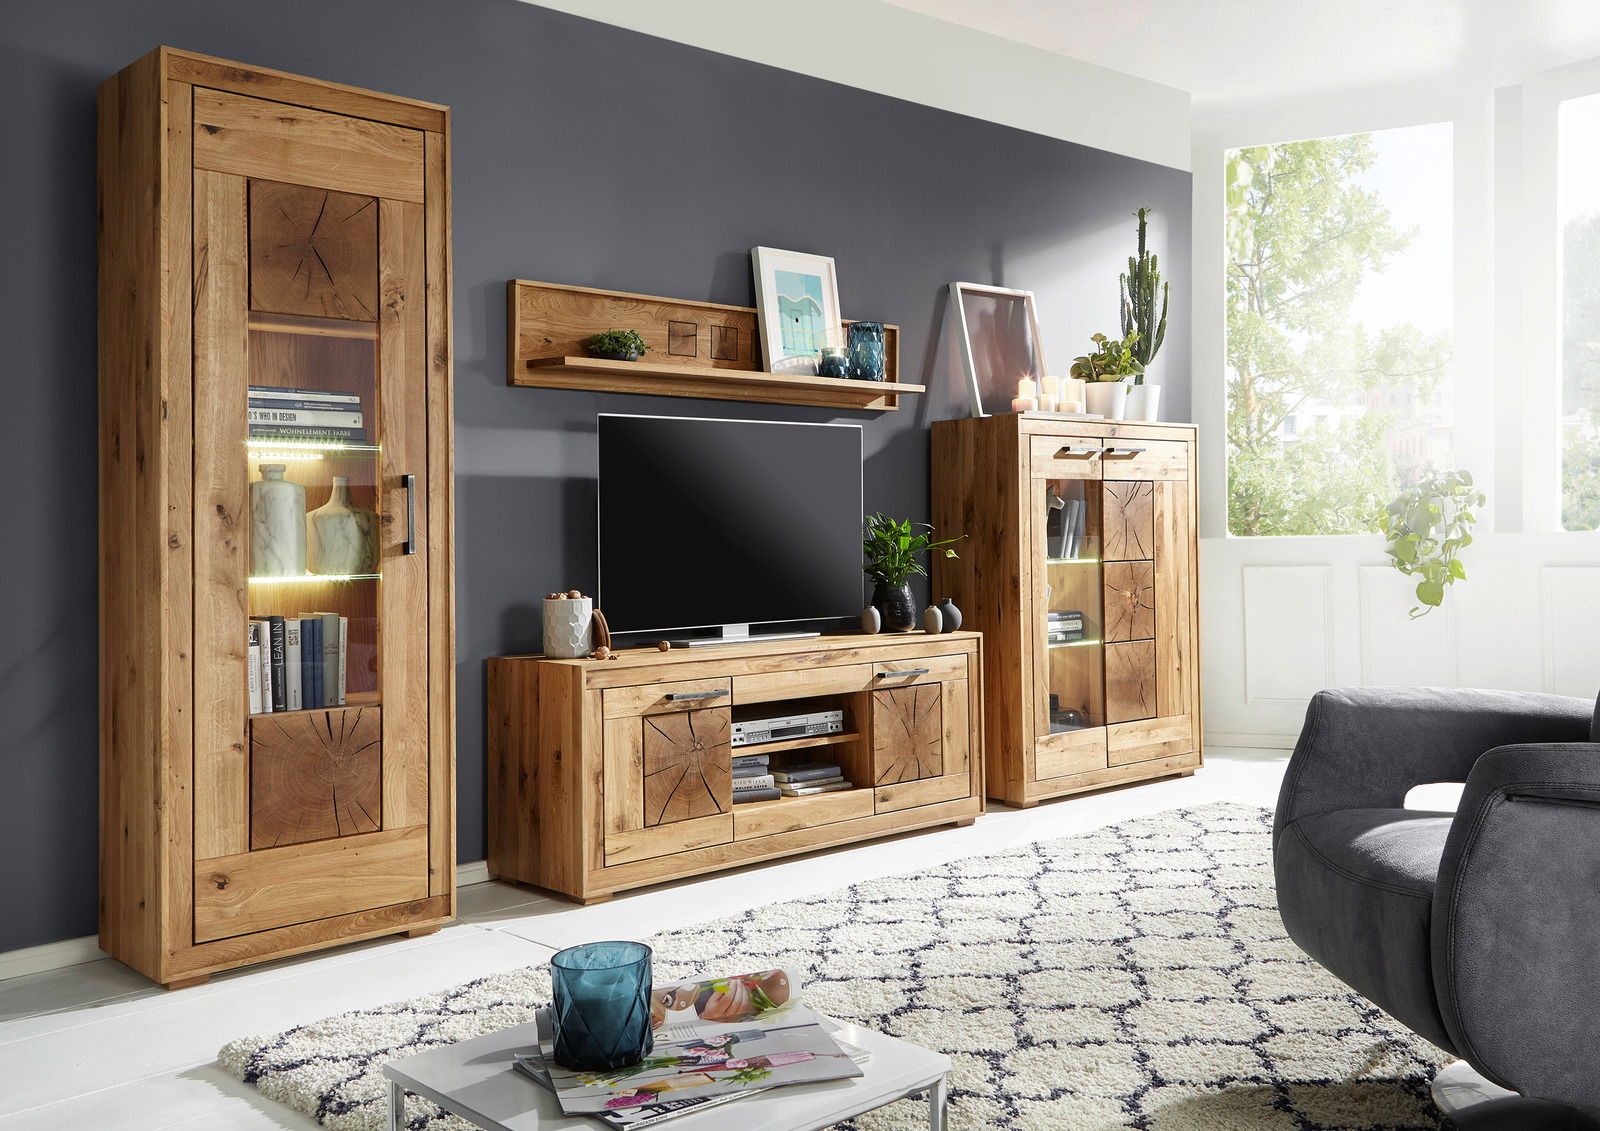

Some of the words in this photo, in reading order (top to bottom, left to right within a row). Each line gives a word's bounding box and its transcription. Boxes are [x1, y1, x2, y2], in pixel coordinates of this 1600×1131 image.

[259, 412, 271, 421] WHO
[272, 413, 278, 421] IN
[279, 413, 297, 422] DESIGN
[279, 428, 331, 436] WOHNELEMENT
[273, 622, 282, 634] IN
[273, 637, 283, 666] LEAN
